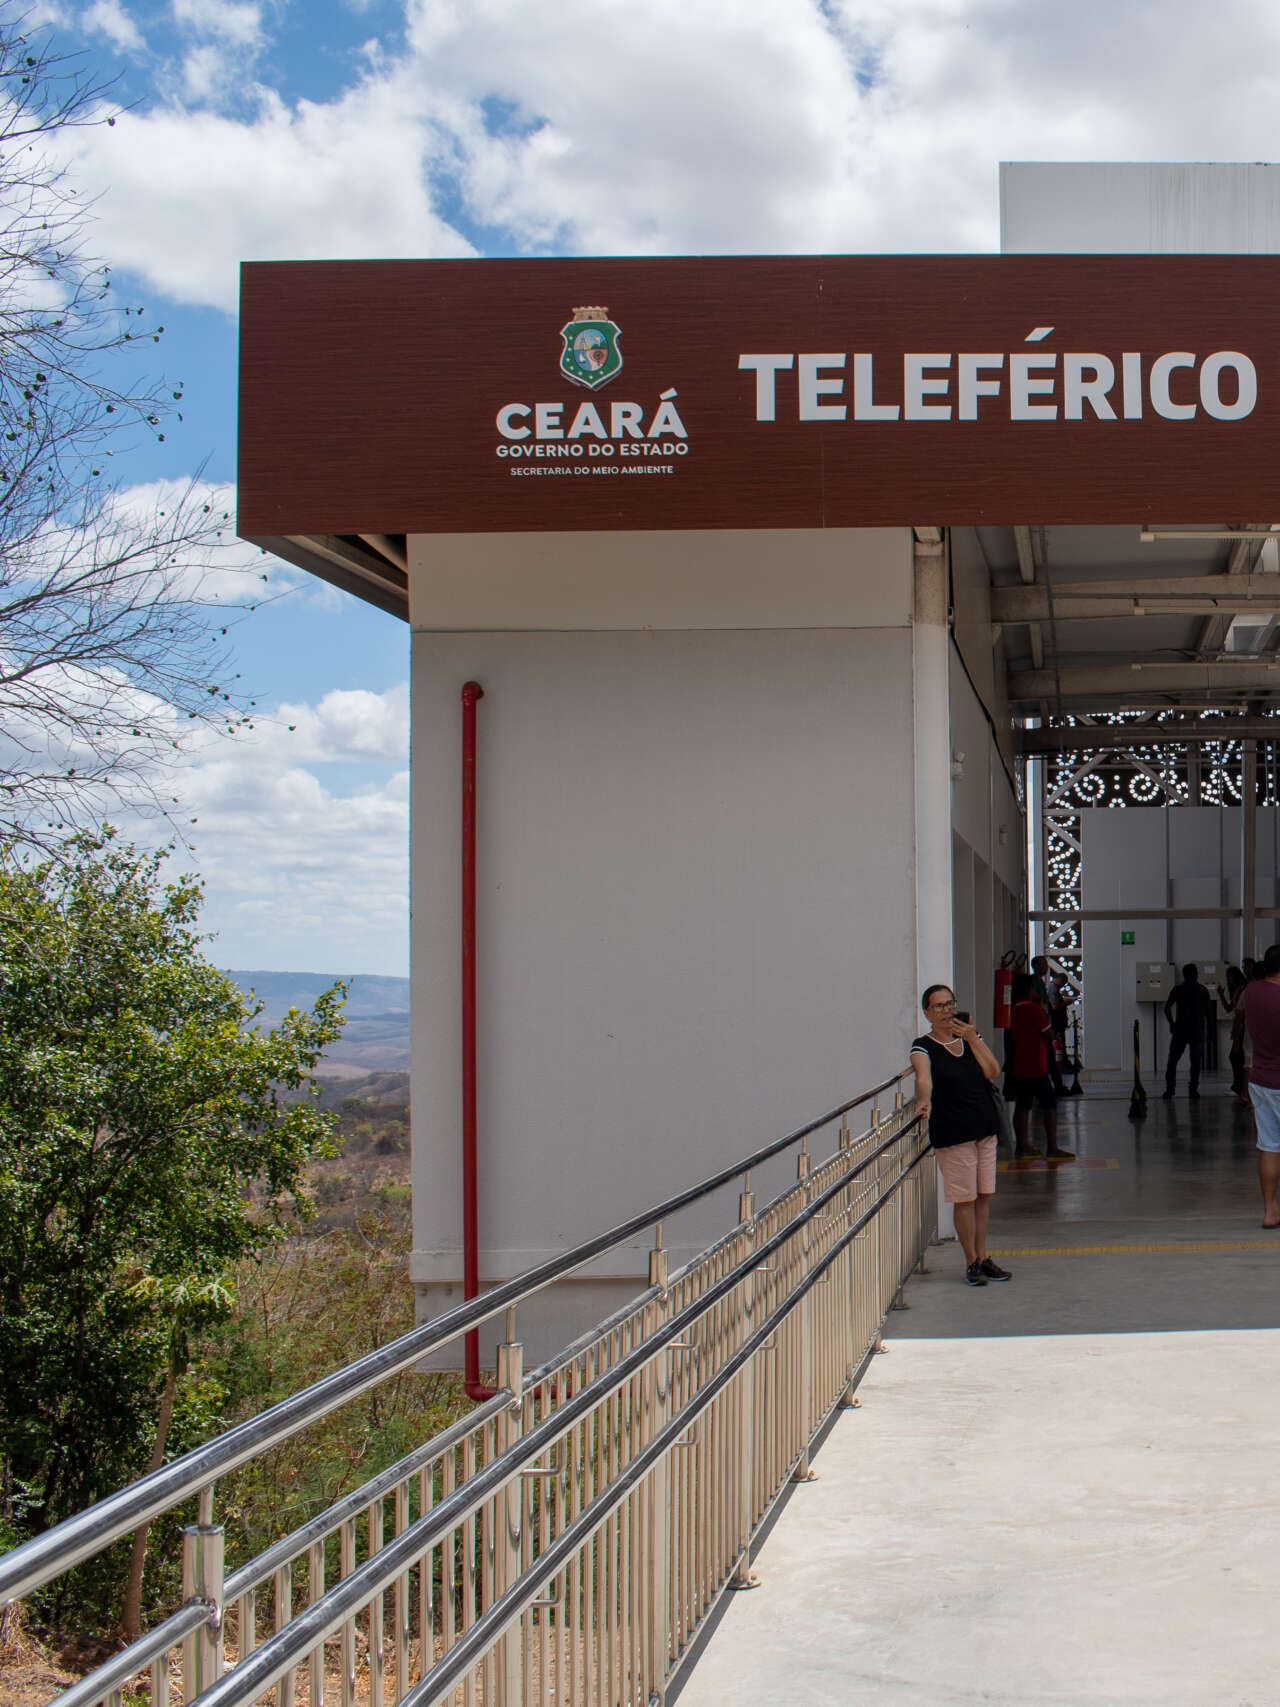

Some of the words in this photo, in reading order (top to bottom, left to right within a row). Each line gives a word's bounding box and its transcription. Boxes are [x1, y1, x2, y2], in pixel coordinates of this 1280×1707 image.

[738, 327, 1258, 423] TELEFÉRICO
[495, 387, 689, 440] CEARÁ
[495, 443, 584, 458] GOVERNO
[588, 443, 615, 457] DO
[620, 442, 689, 456] ESTADO
[510, 466, 573, 476] SECRETARIA
[574, 466, 590, 475] DO
[592, 466, 619, 475] MEIO
[621, 465, 674, 475] AMBIENTE
